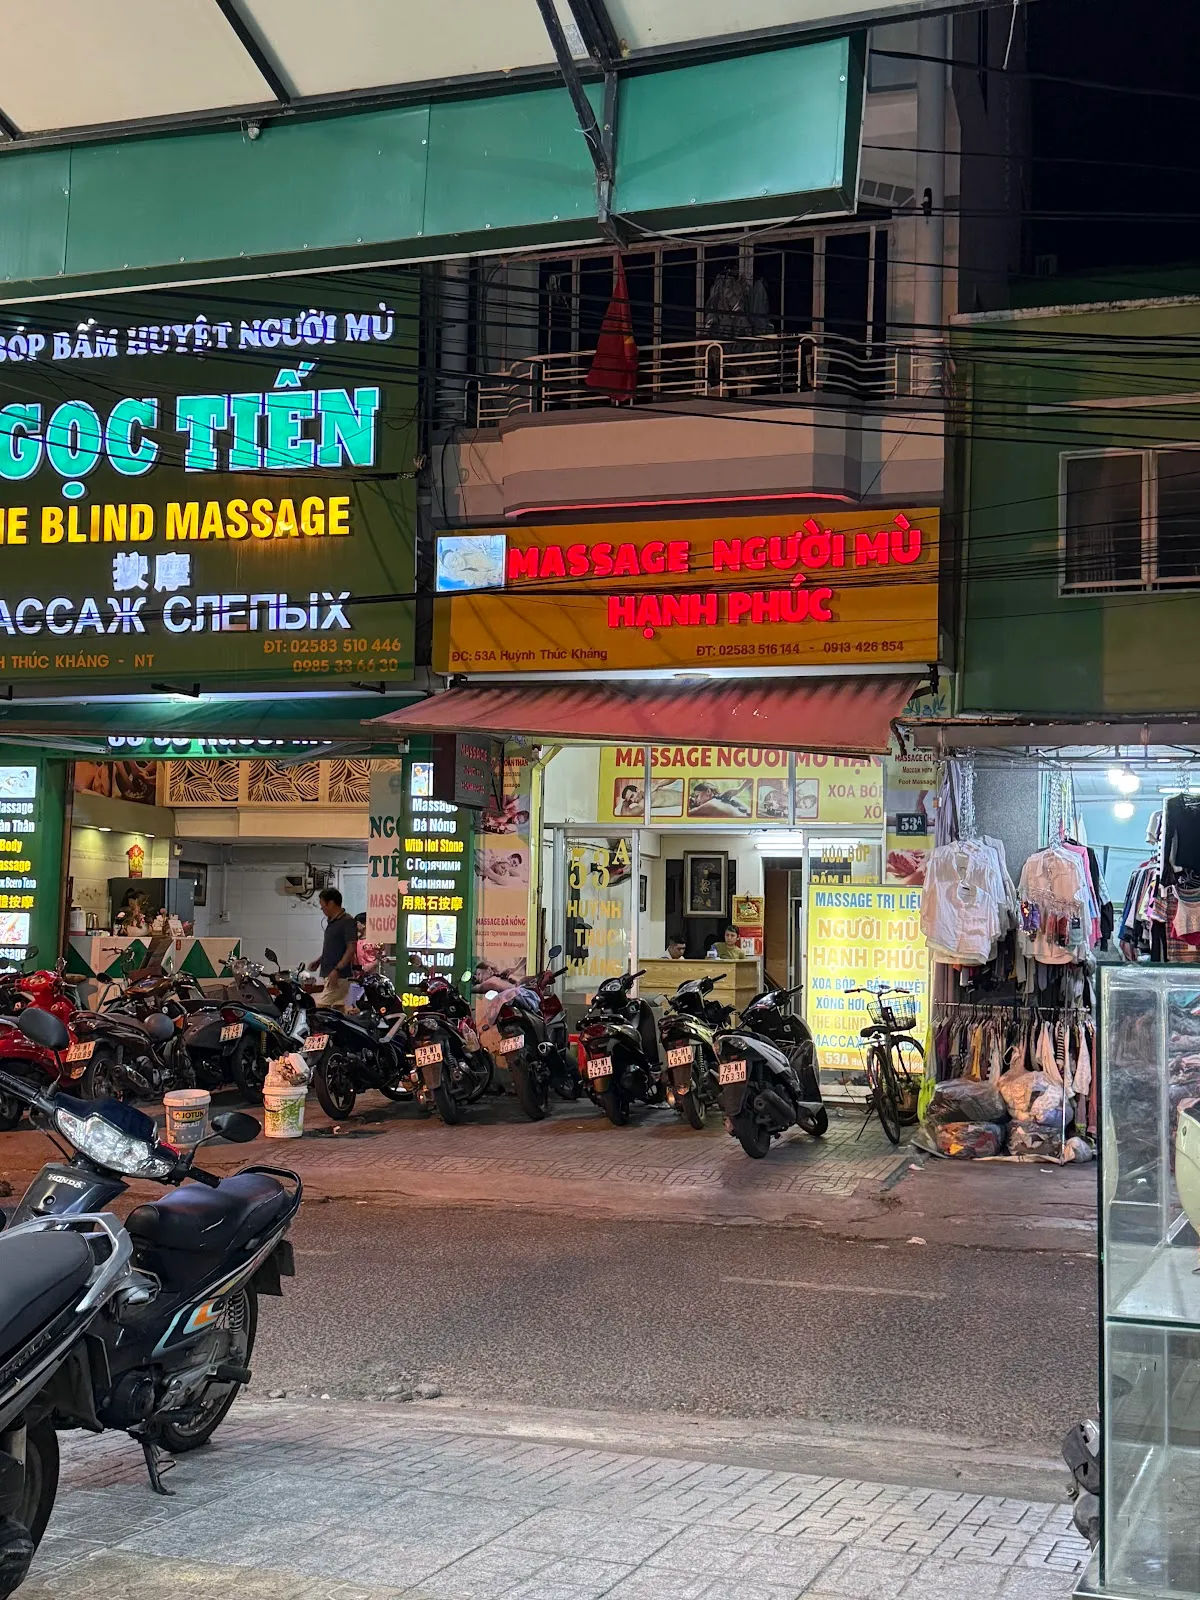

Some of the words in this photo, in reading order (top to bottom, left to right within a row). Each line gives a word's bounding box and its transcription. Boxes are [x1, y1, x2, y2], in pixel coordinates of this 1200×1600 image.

[176, 357, 380, 472] TIẾN
[41, 503, 154, 544] BLIND
[165, 496, 350, 541] MASSAGE
[508, 541, 689, 579] MASSAGE
[713, 518, 845, 572] NGƯỜI
[855, 513, 922, 566] MÙ
[162, 591, 352, 633] СЛЕПЫХ
[608, 591, 718, 640] HẠNH
[728, 572, 833, 624] PHÚC
[263, 640, 288, 653] ĐT:
[290, 640, 337, 653] 02583
[343, 639, 367, 652] 510
[371, 637, 401, 652] 446
[696, 646, 716, 656] ĐT:
[719, 645, 756, 655] 02583
[758, 643, 778, 654] 516
[781, 643, 800, 655] 144
[823, 642, 850, 653] 0913
[855, 641, 878, 652] 426
[881, 641, 904, 651] 854
[11, 650, 50, 669] THÚC
[54, 650, 110, 669] KHÁNG
[134, 654, 155, 668] NT
[452, 653, 472, 662] ĐC:
[474, 651, 497, 661] 53A
[540, 647, 567, 660] Thúc
[616, 747, 712, 767] MASSAGE
[828, 785, 855, 798] XOA
[12, 818, 35, 833] Thân
[413, 819, 427, 832] Đá
[430, 818, 457, 834] Nóng
[405, 839, 423, 852] With
[440, 839, 464, 853] Stone
[815, 892, 872, 908] MASSAGE
[877, 894, 894, 912] TRỊ
[873, 946, 926, 969] PHÚC
[812, 978, 831, 989] XOA
[48, 1173, 86, 1190] HONDA
